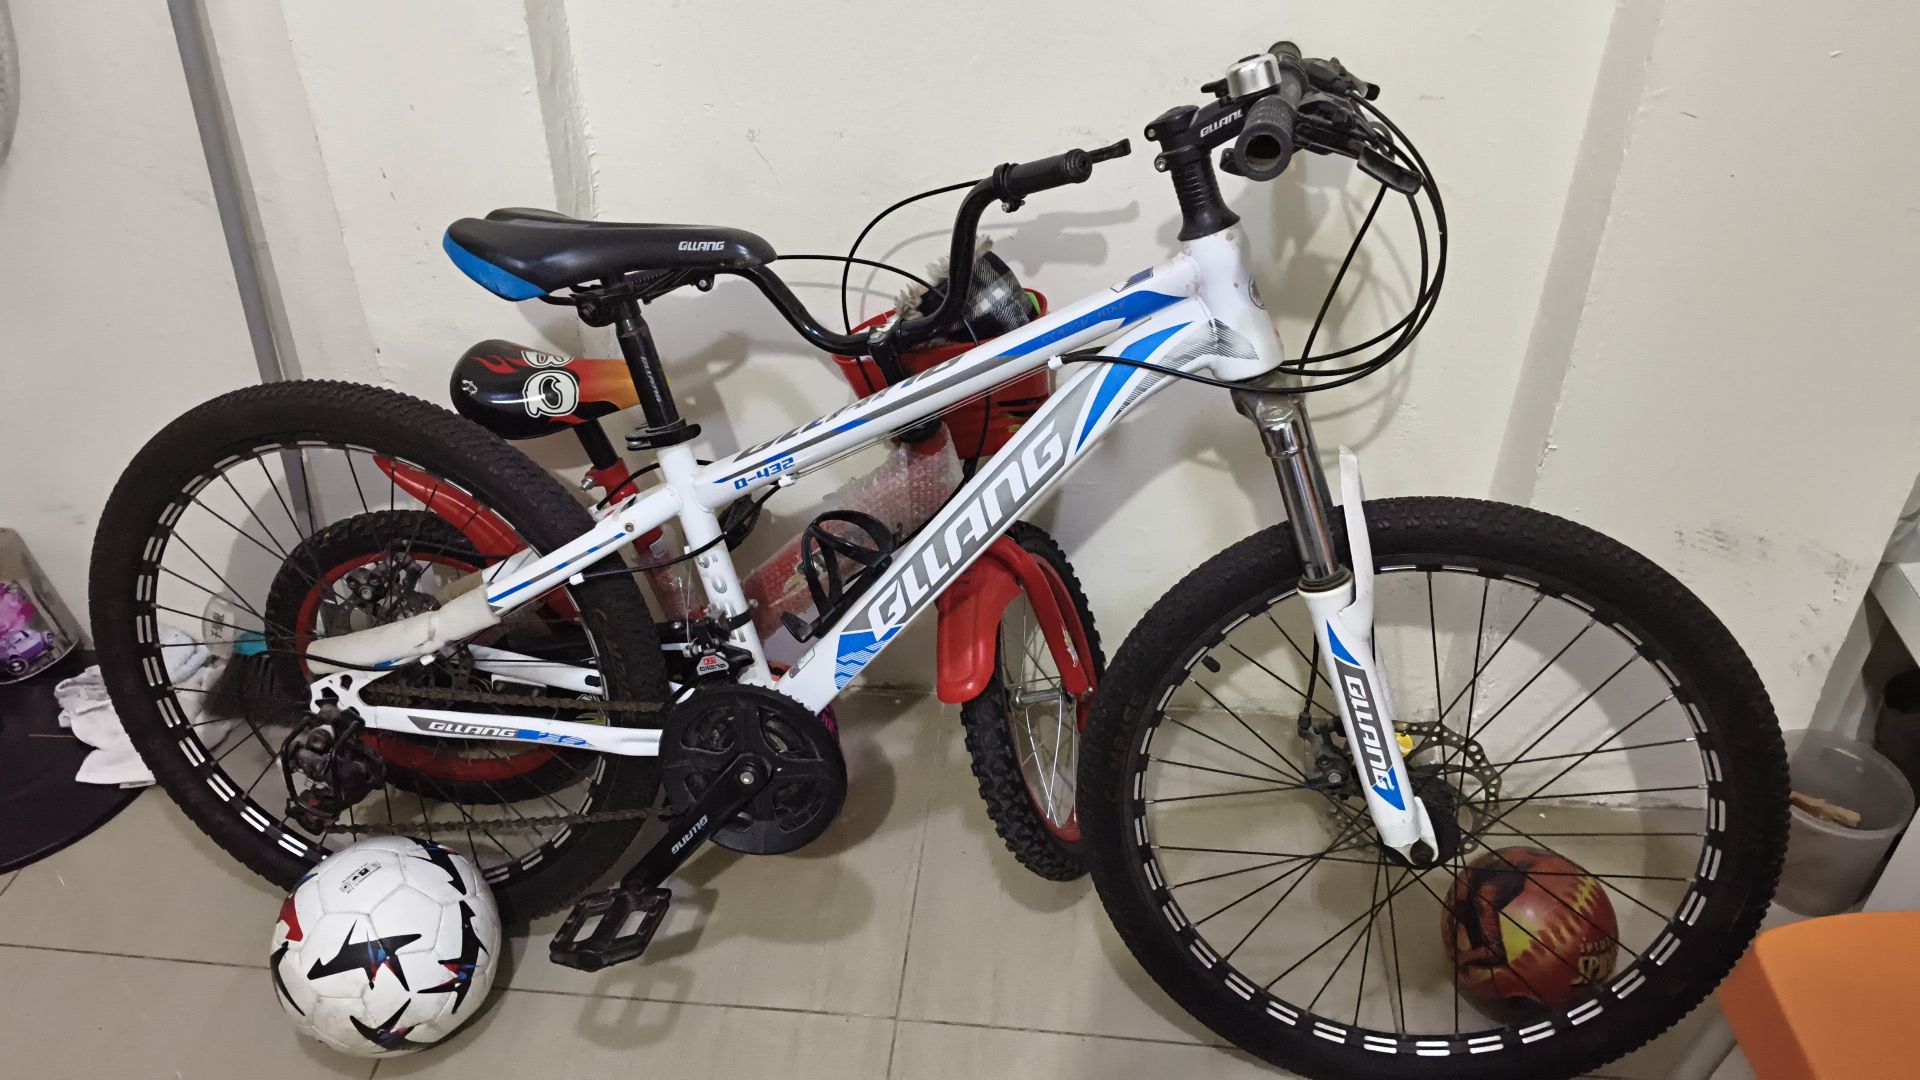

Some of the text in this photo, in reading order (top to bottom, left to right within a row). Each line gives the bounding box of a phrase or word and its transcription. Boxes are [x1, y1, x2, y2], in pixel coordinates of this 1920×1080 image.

[678, 240, 725, 252] GLLANG
[867, 418, 1064, 642] GLLANG
[428, 720, 517, 738] GLLANG
[1344, 674, 1396, 791] GLLANG
[671, 814, 709, 855] GLLANG
